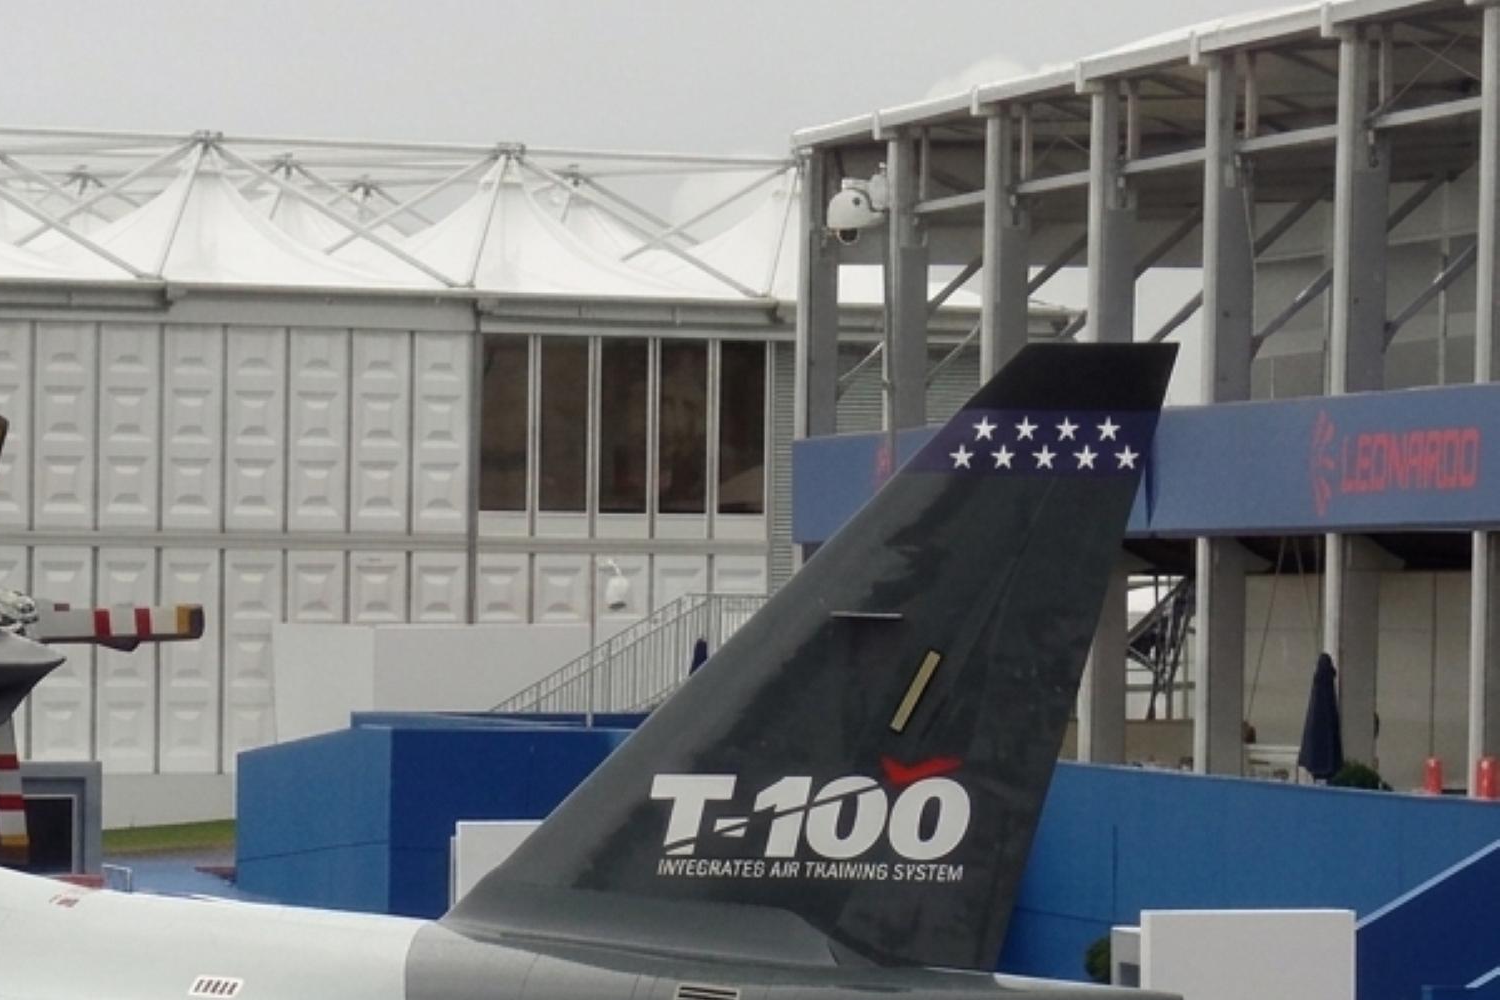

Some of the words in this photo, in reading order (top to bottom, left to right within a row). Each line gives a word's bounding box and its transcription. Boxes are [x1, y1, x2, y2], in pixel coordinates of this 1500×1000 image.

[1341, 427, 1480, 493] LEONARDO
[650, 773, 971, 860] T-100
[768, 860, 801, 878] AIR
[804, 861, 889, 881] TRAINING
[892, 863, 965, 882] SYSTEM
